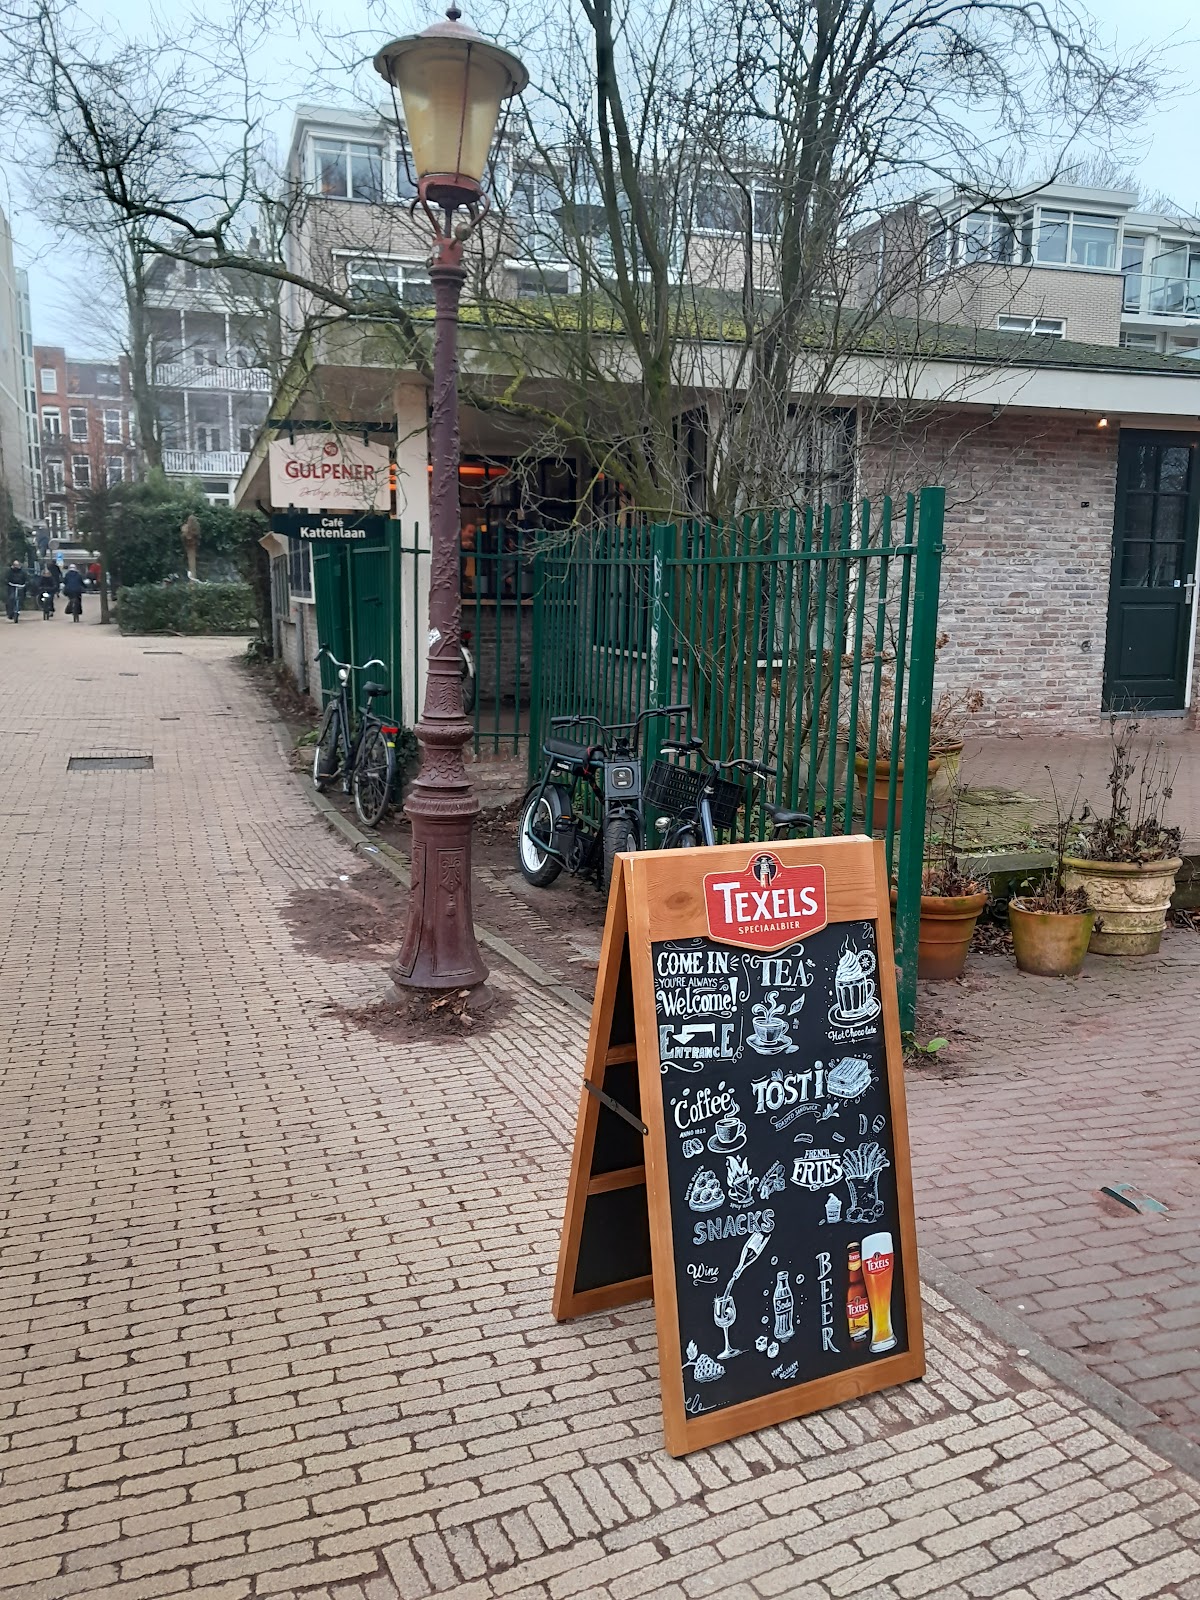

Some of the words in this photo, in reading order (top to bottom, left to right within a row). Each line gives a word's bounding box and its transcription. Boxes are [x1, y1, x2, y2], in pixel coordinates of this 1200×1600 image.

[285, 461, 375, 480] GULPENER
[321, 518, 344, 527] Café
[300, 527, 365, 538] Kattenlaan
[713, 881, 818, 924] TEXELS
[738, 921, 801, 935] SPECIAALBIER
[657, 952, 703, 976] COME
[707, 951, 730, 974] IN
[753, 958, 814, 987] TEA
[658, 977, 687, 988] YOU'RE
[688, 977, 718, 988] ALWAYS
[656, 977, 739, 1018] Welcome!
[659, 1023, 735, 1060] ENTRANCE
[674, 1088, 731, 1129] Coffee
[804, 1149, 830, 1158] FRENCH
[791, 1159, 843, 1185] FRIES
[693, 1209, 775, 1245] SNACKS
[687, 1263, 719, 1279] Wine
[866, 1259, 890, 1272] TEXELS
[776, 1300, 791, 1312] Soda
[815, 1251, 840, 1353] BEER
[847, 1303, 869, 1315] TEXELS
